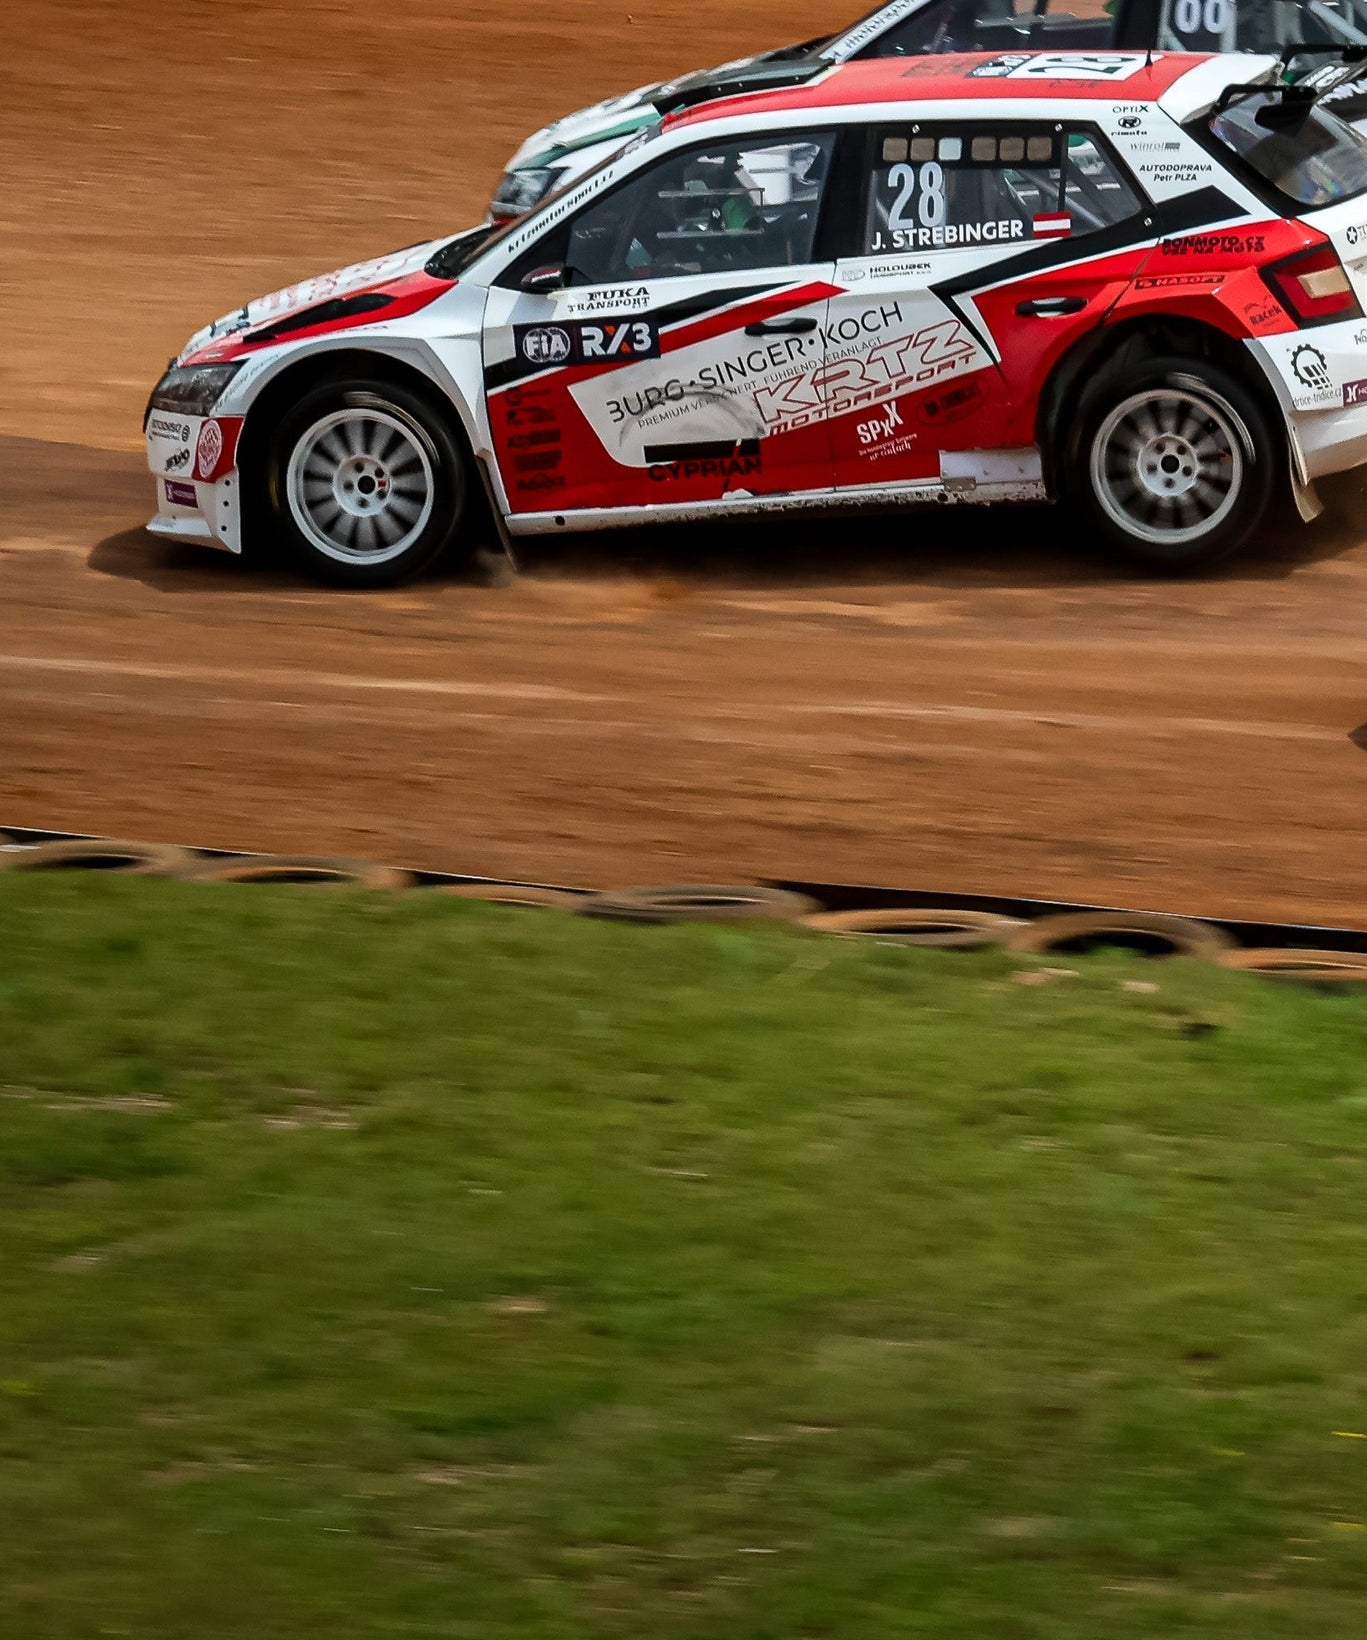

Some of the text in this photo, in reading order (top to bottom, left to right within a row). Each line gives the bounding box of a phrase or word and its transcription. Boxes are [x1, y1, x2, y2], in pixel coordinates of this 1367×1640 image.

[1139, 164, 1212, 173] AUTODOPRAVA
[887, 161, 946, 231] 28
[871, 219, 1024, 251] J. STREBINGER
[567, 296, 650, 314] TRANSPORT
[587, 286, 649, 301] FUKA
[525, 321, 652, 359] FIA RX3
[698, 336, 808, 390] SINGER
[818, 300, 904, 350] KOCH
[752, 318, 975, 425] KRTZ
[637, 404, 690, 430] PREMIUM
[648, 457, 762, 482] CYPRIAN
